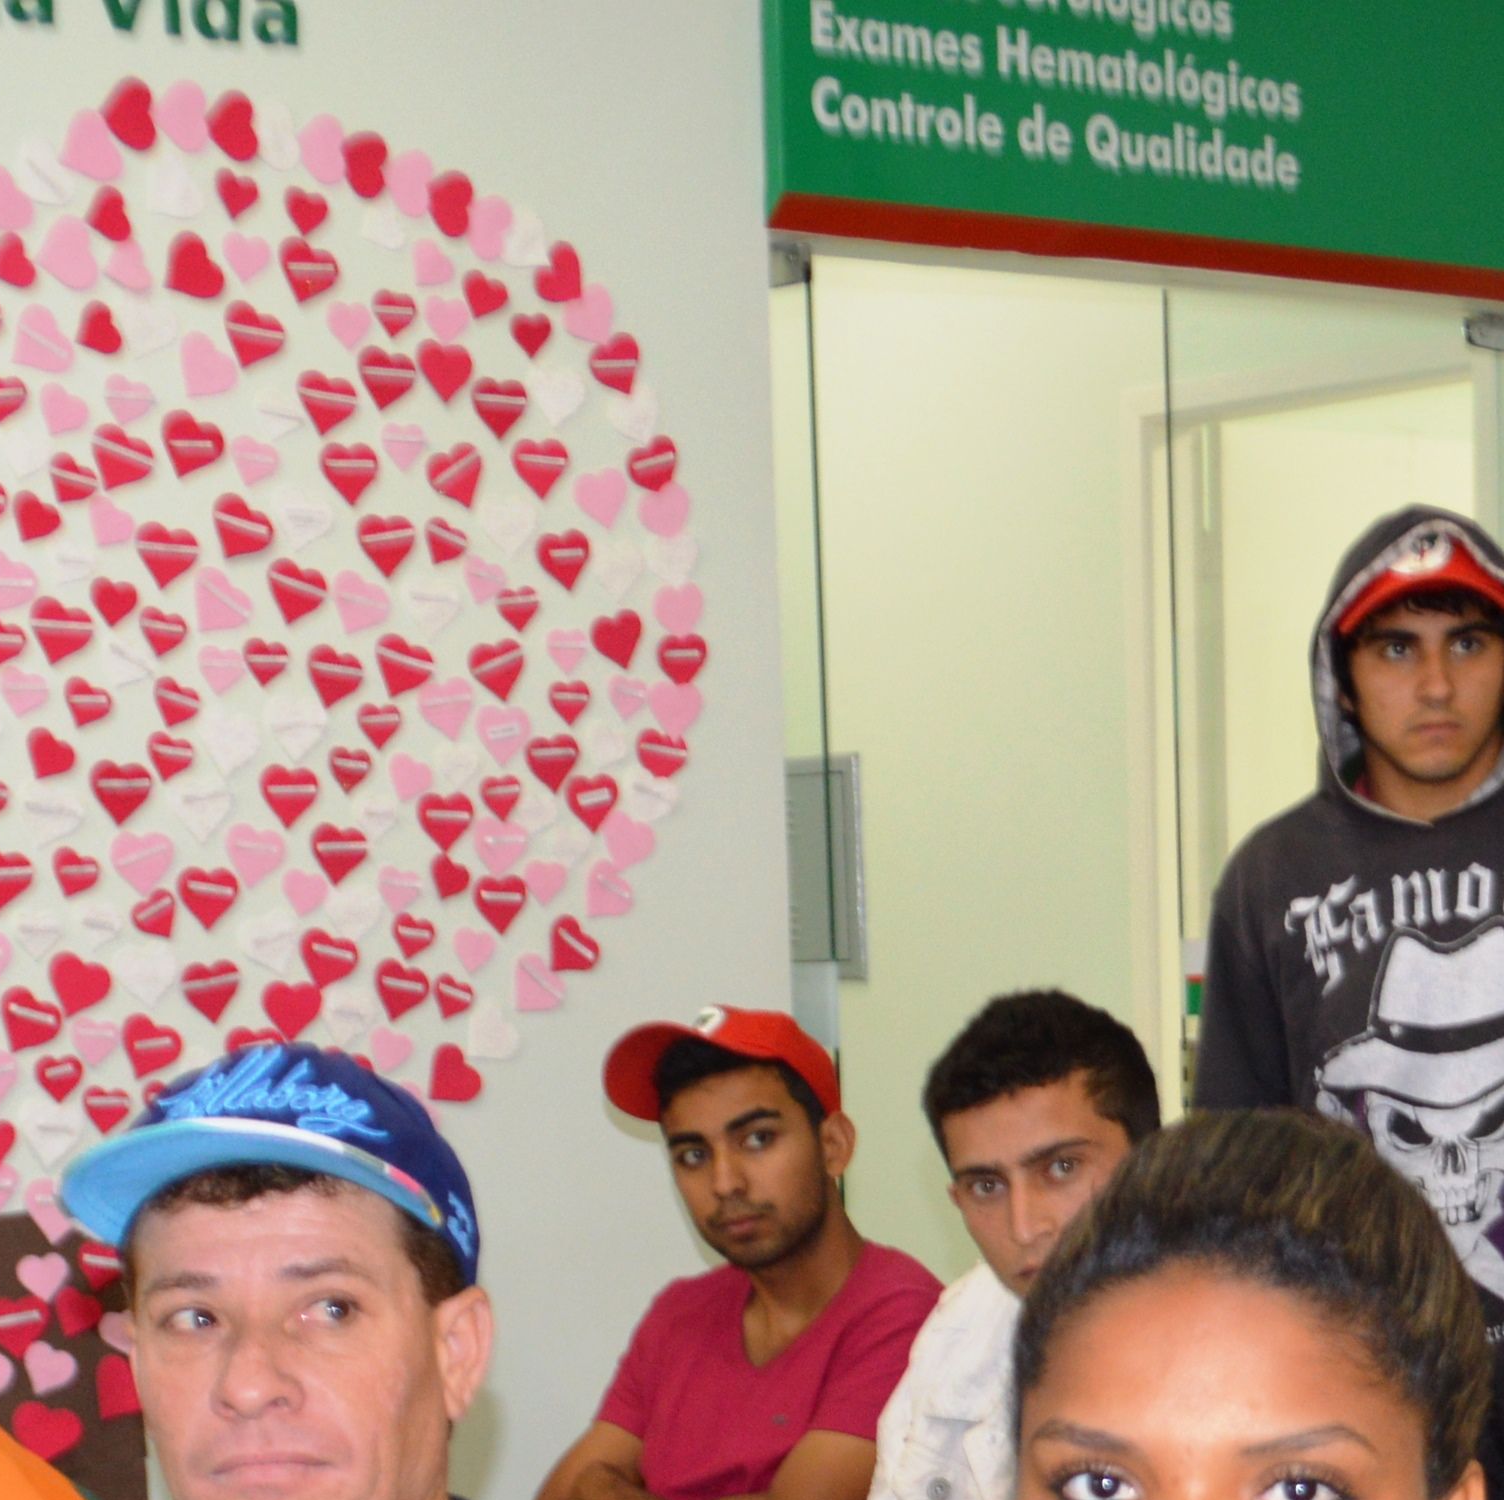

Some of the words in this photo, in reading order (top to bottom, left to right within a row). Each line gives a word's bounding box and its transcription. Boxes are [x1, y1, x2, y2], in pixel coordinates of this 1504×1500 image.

[104, 0, 299, 45] Vida
[810, 0, 984, 70] Exames
[996, 25, 1302, 118] Hematológicos
[811, 76, 1003, 153] Controle
[1018, 105, 1071, 157] de
[1084, 113, 1301, 187] Qualidade
